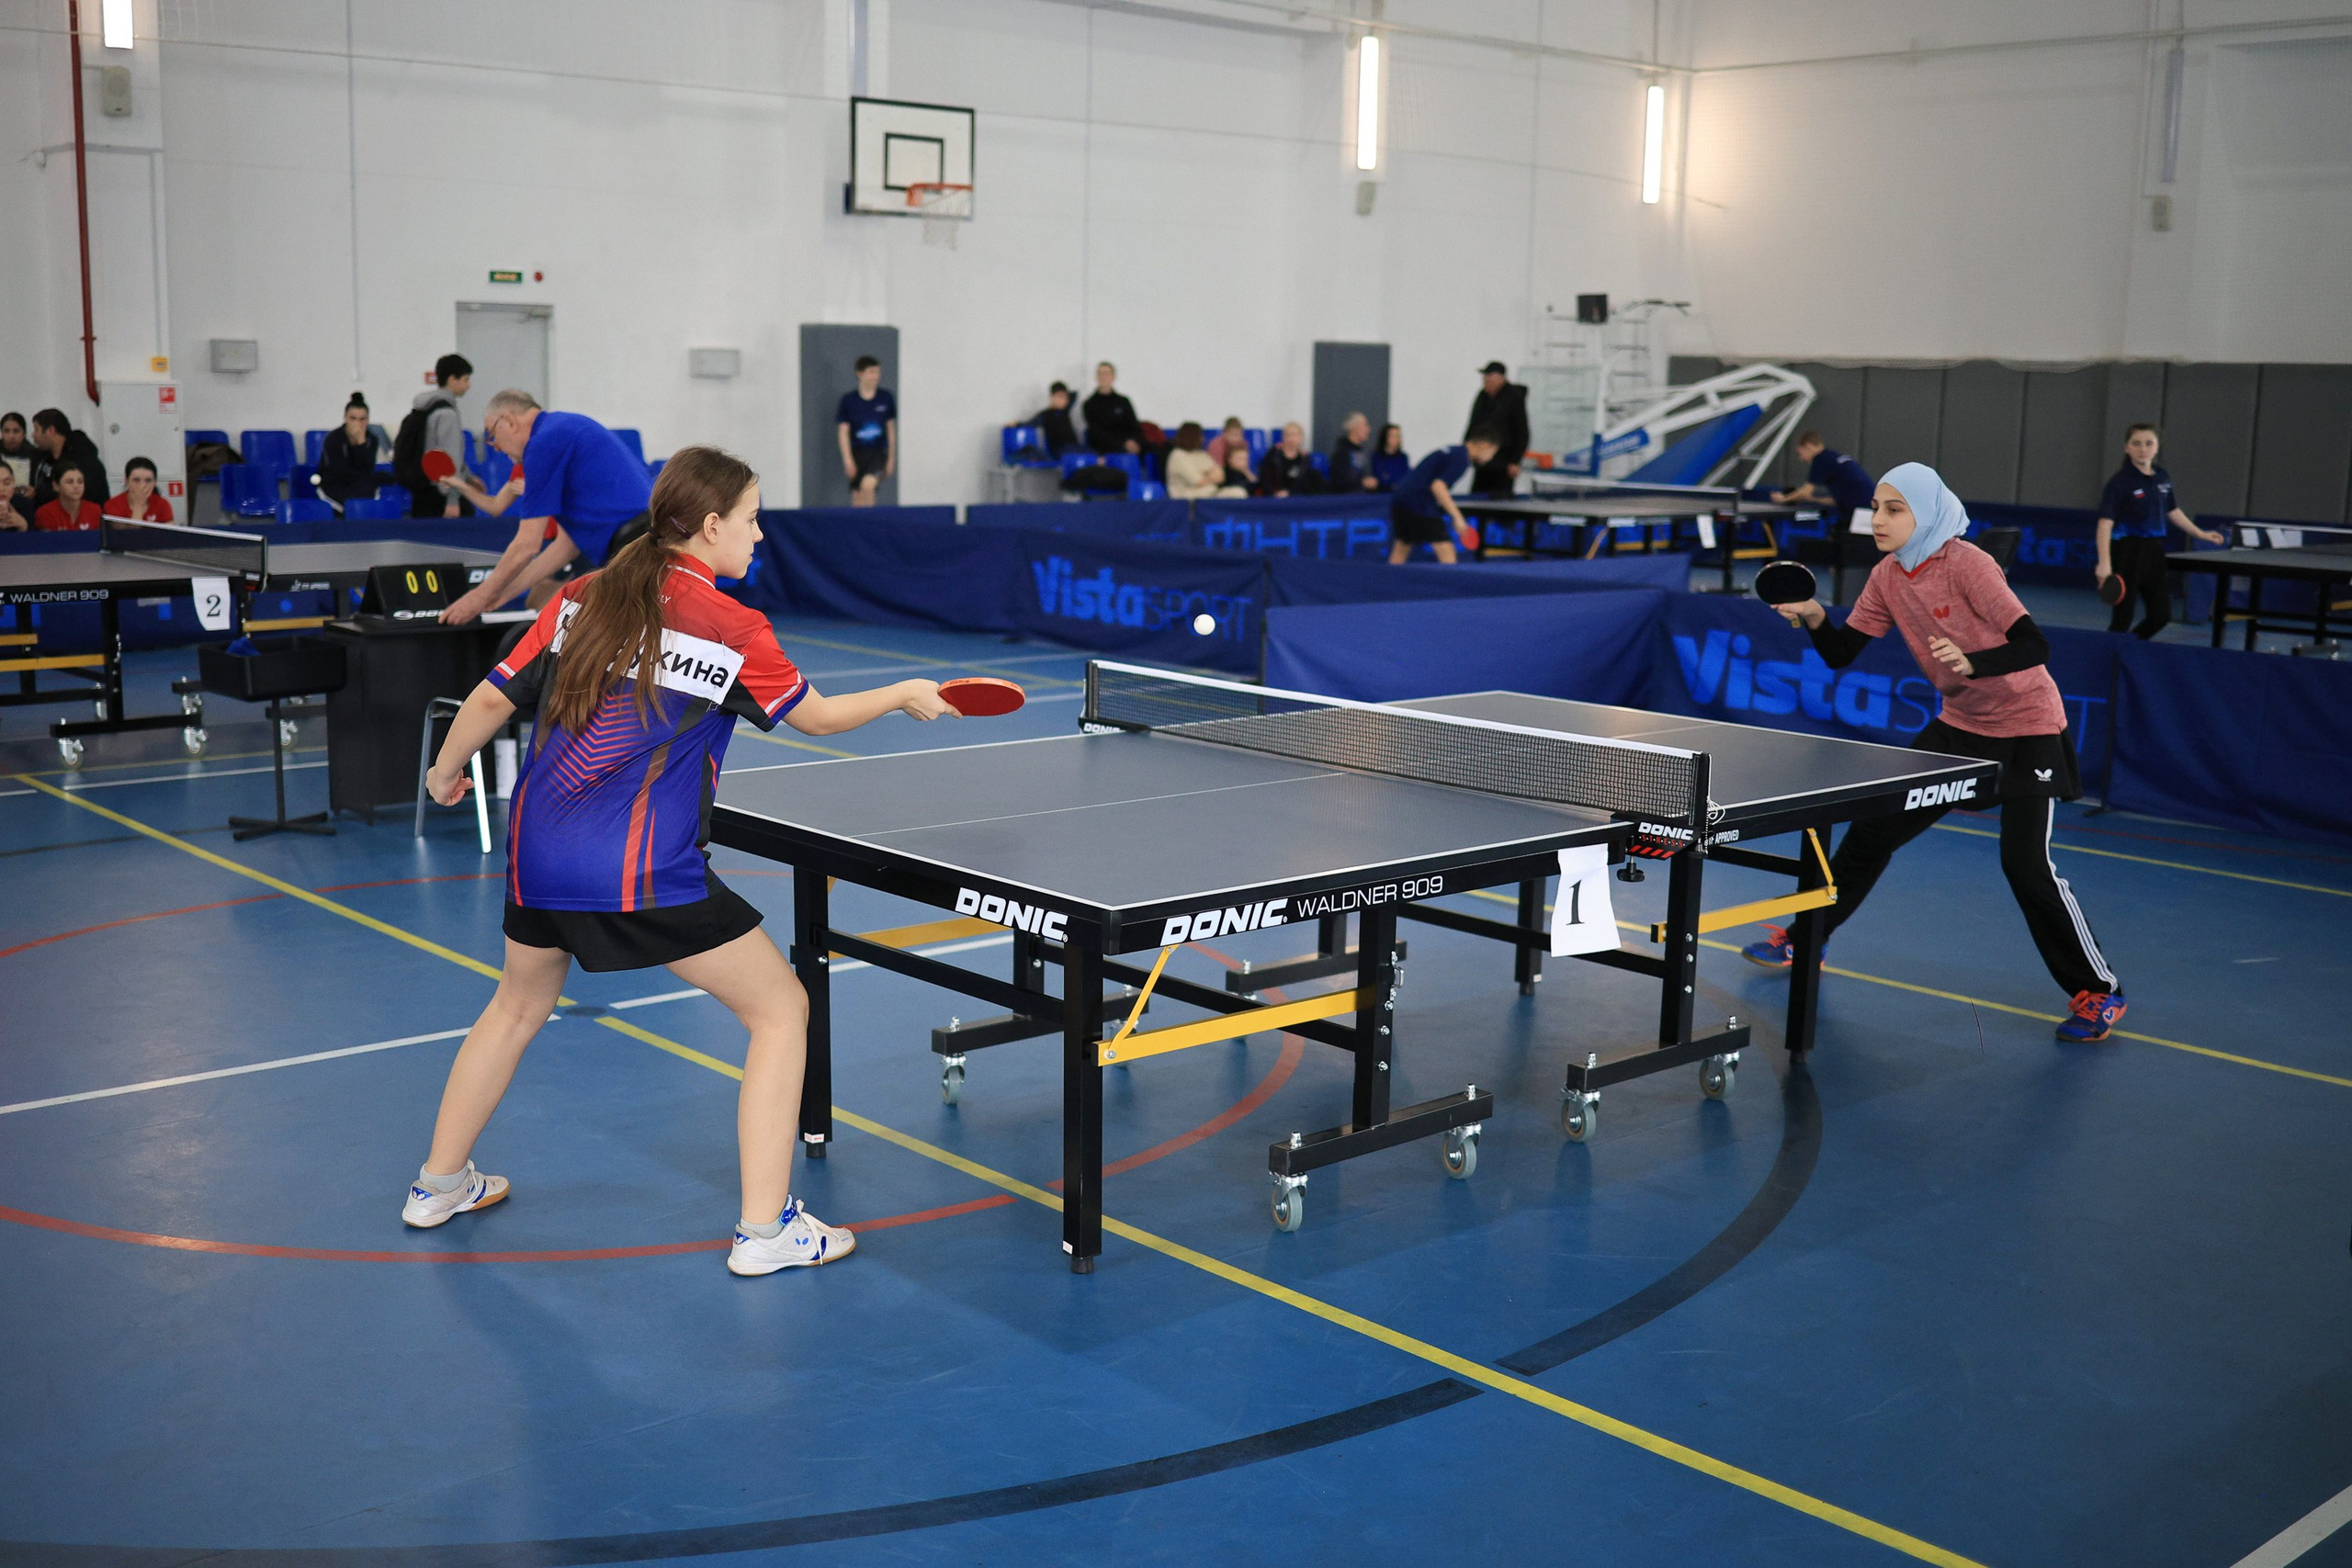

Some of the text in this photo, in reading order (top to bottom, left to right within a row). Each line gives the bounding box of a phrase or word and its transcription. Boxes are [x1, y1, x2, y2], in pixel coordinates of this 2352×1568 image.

[406, 570, 438, 594] 0 0
[10, 591, 77, 604] WALDNER
[80, 589, 109, 601] 909
[206, 594, 221, 617] 2
[1905, 778, 1977, 811] DONIC
[1638, 821, 1693, 840] DONIC
[955, 886, 1069, 942] DONIC
[1160, 875, 1443, 946] DONIC WALDNER 909
[1566, 879, 1585, 926] 1
